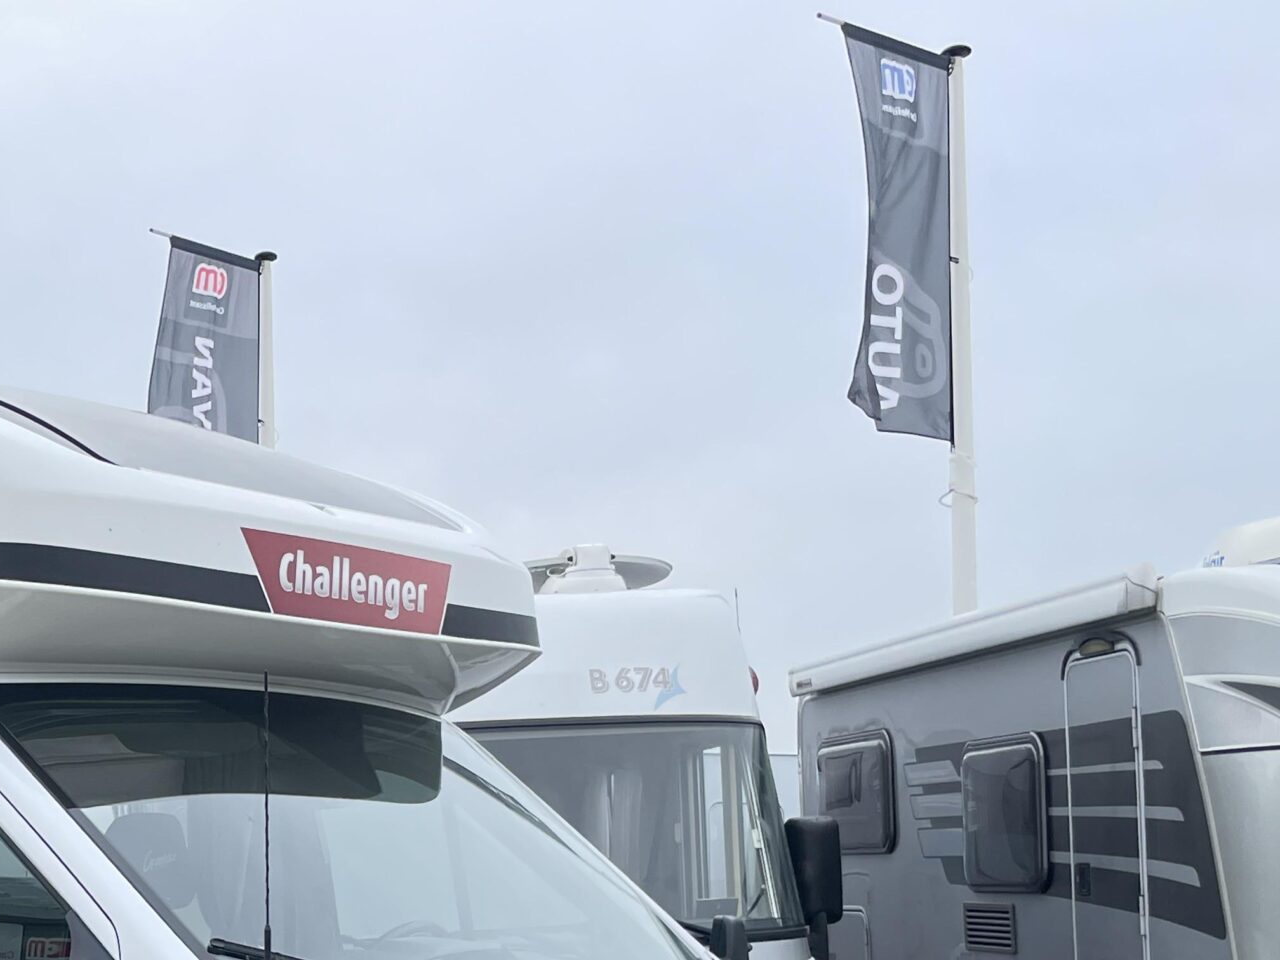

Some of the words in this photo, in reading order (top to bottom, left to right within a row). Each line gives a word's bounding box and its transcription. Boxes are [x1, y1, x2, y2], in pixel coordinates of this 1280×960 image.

[278, 549, 428, 620] Challenger
[588, 668, 610, 694] B
[615, 666, 671, 693] 674
